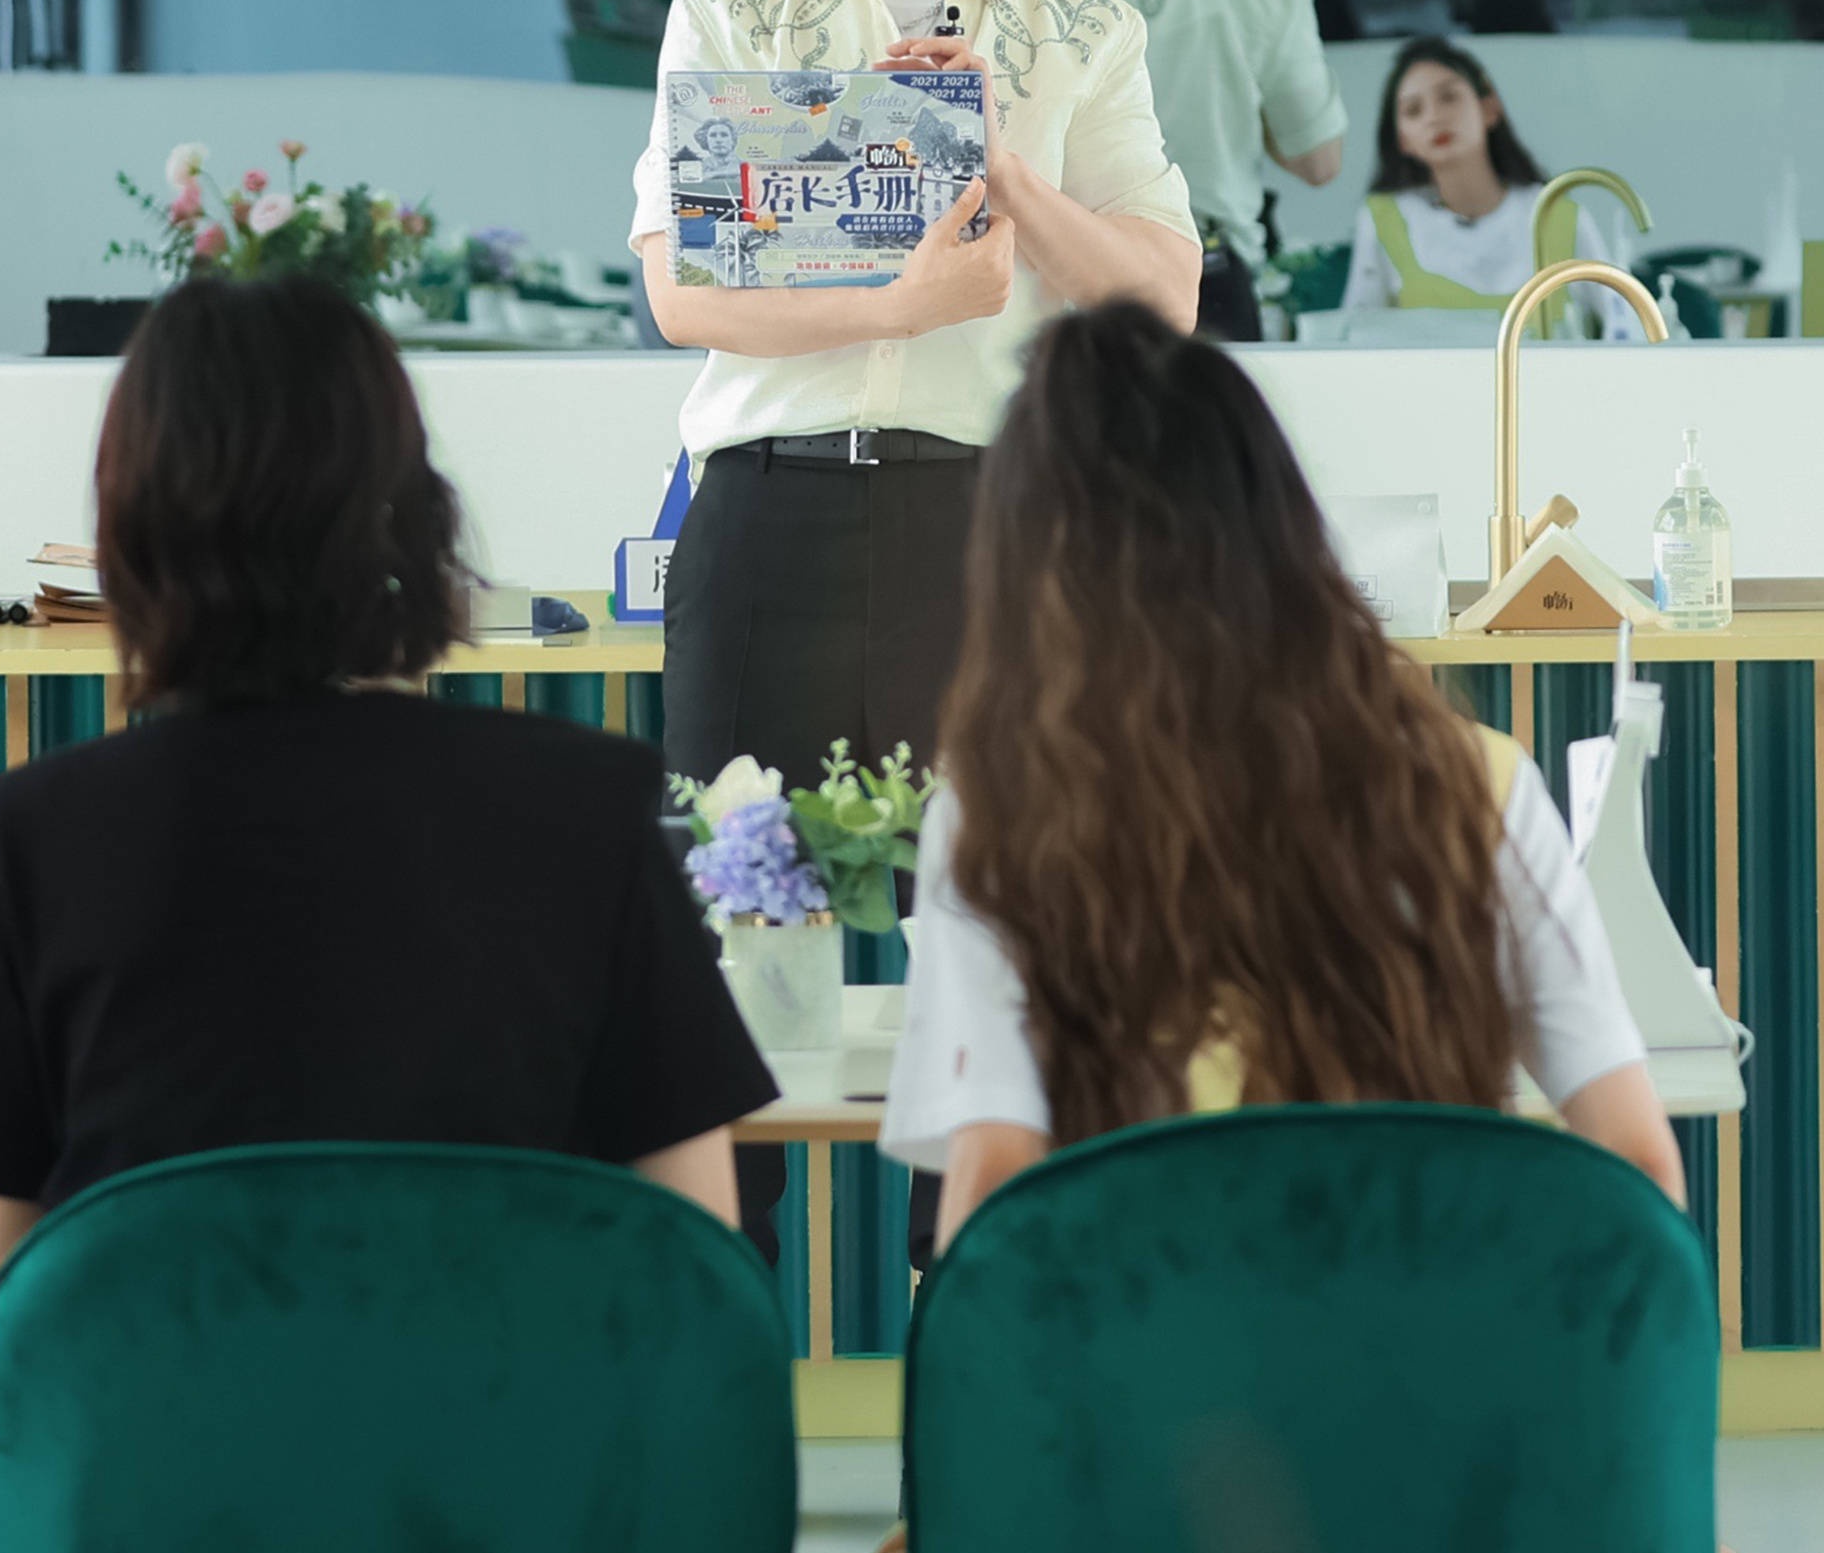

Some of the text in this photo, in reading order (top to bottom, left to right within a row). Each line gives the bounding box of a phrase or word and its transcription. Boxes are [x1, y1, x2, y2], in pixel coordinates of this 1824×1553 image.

[910, 76, 938, 86] 2021
[942, 76, 969, 86] 2021
[758, 165, 916, 212] 店长手册
